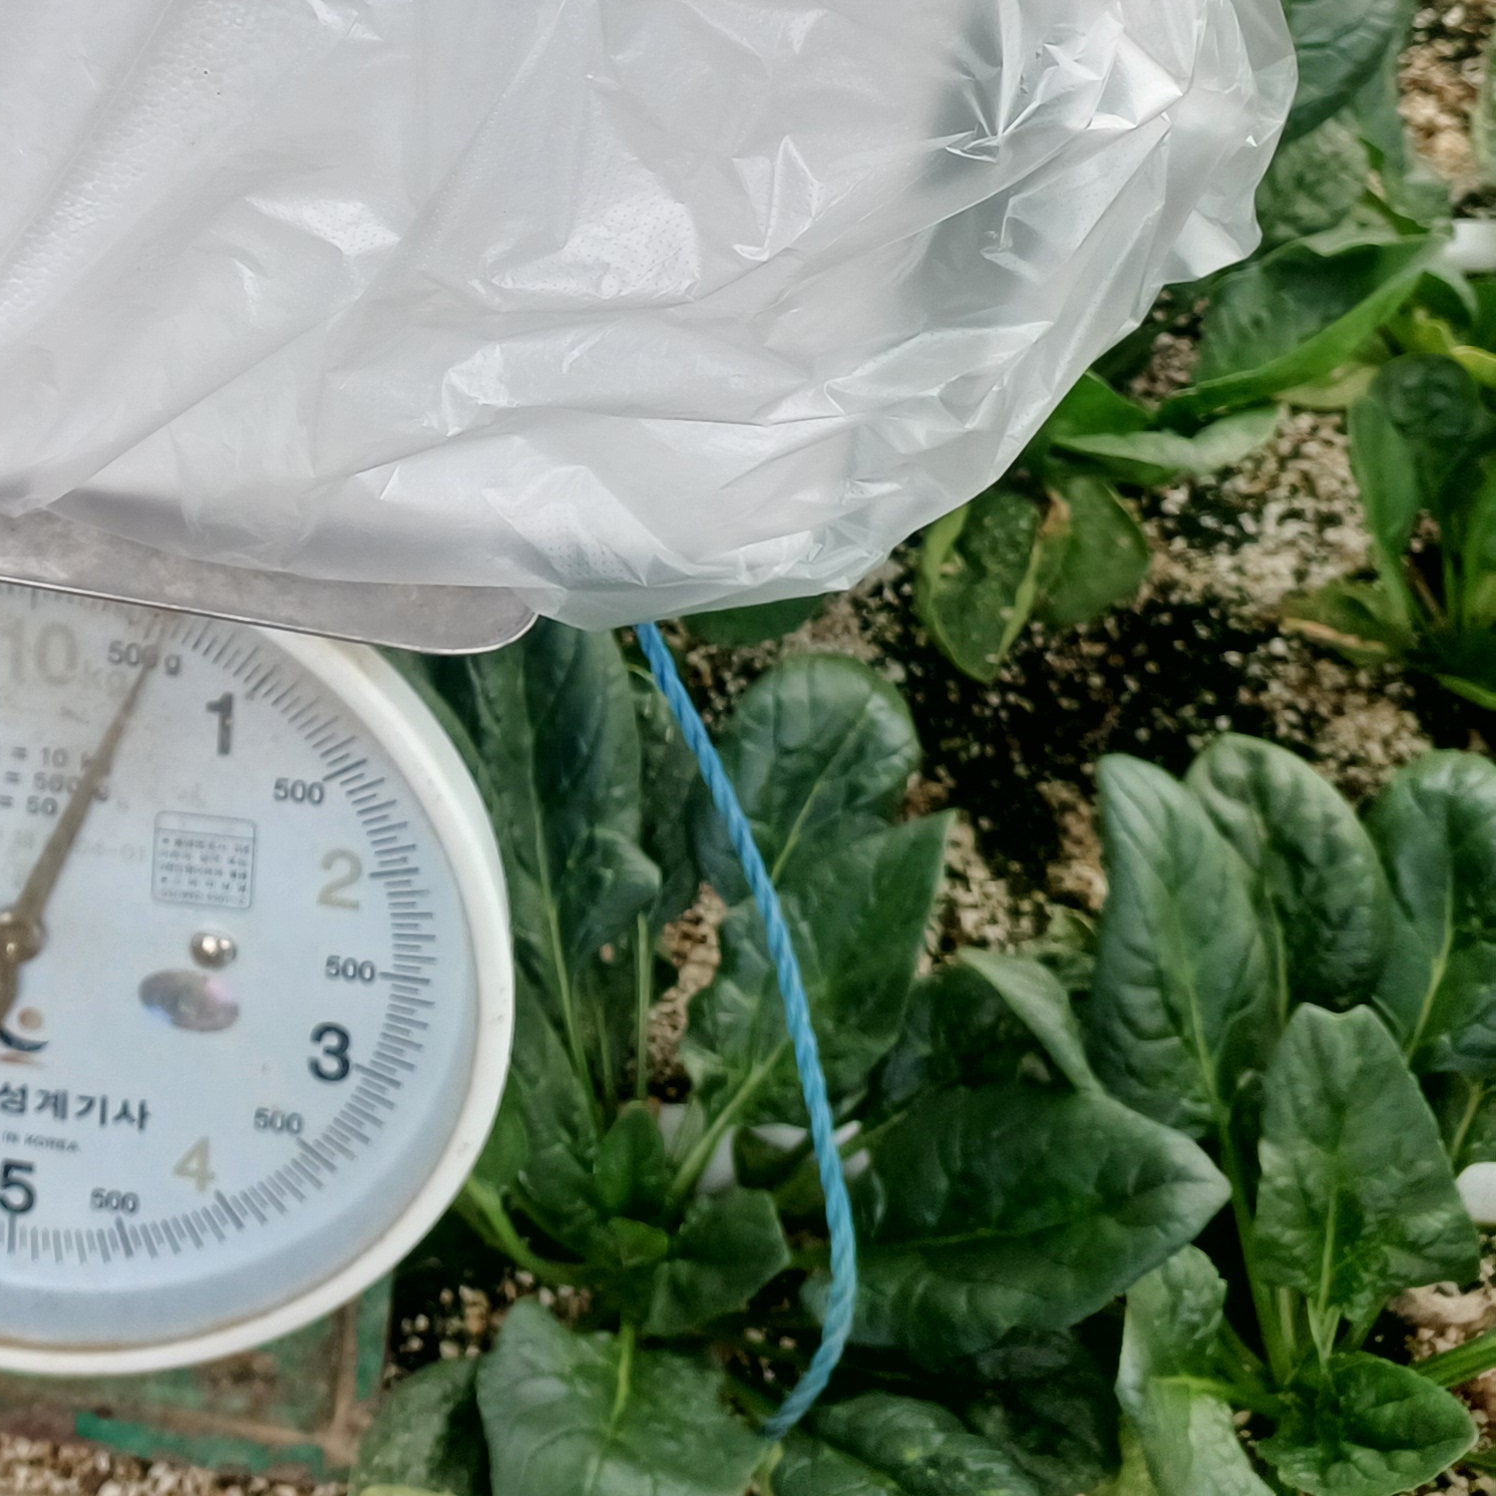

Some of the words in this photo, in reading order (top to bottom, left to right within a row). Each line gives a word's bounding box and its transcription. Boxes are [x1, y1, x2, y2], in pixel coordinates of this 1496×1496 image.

[1, 618, 78, 686] 10
[206, 691, 234, 756] 1
[40, 747, 69, 768] 10
[273, 776, 325, 806] 500
[316, 848, 362, 911] 2
[325, 954, 376, 985] 500
[307, 1021, 352, 1085] 3
[254, 1107, 303, 1136] 500
[173, 1136, 215, 1192] 4
[90, 1187, 141, 1215] 500
